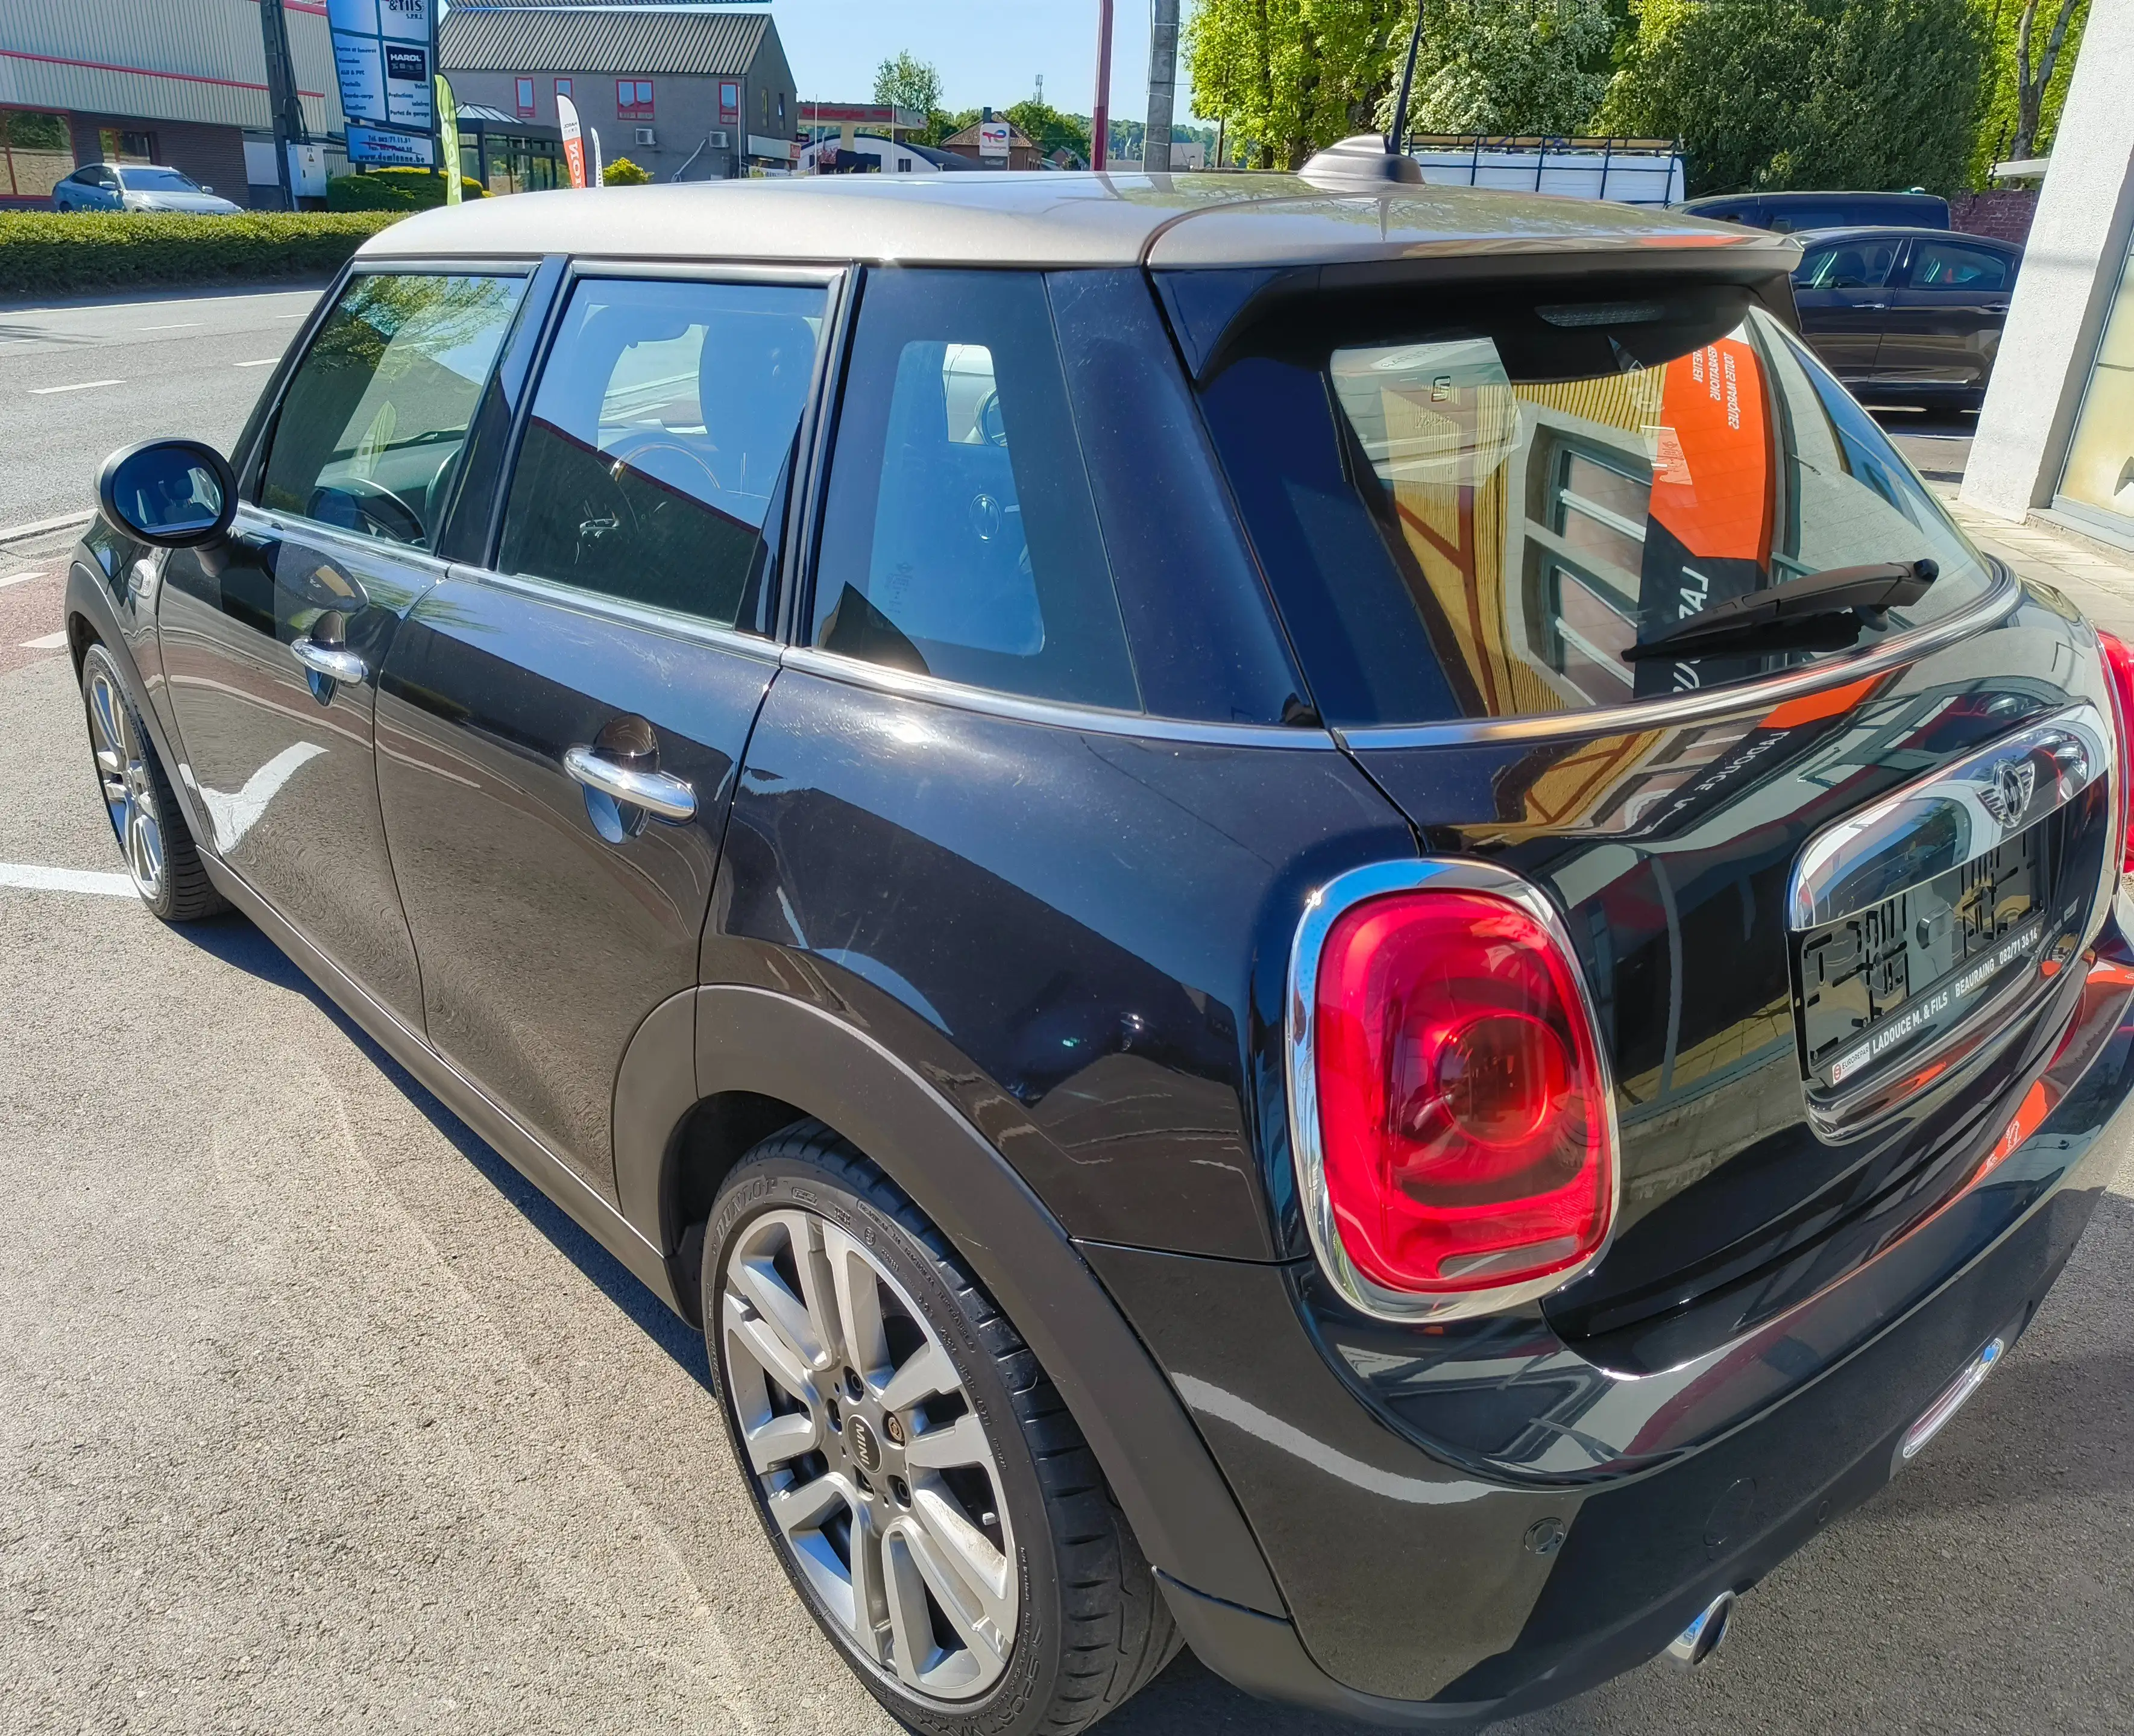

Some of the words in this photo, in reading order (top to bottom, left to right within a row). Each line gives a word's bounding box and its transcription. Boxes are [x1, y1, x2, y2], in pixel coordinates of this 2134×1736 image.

[1872, 1017, 1912, 1054] LADOUCE
[1923, 1004, 1930, 1019] &
[1931, 992, 1948, 1014] FILS
[1955, 957, 1995, 998] BEAURAING
[1999, 939, 2020, 964] 082/71
[2021, 933, 2030, 949] 36
[716, 1176, 778, 1244] DUNLOP
[855, 1423, 870, 1465] MINI
